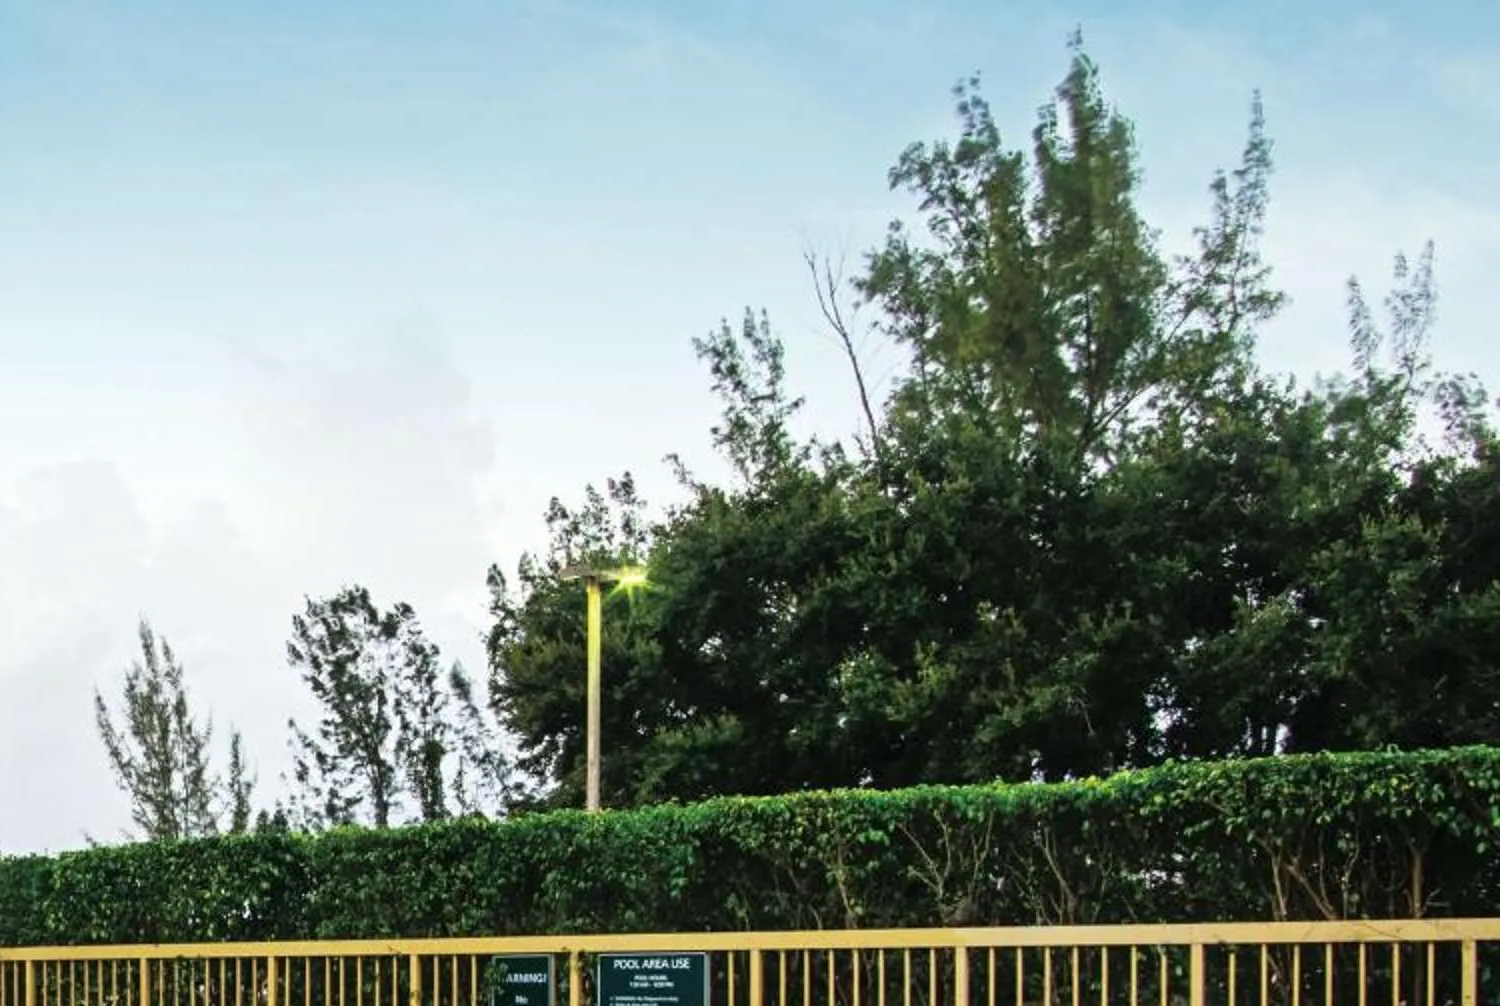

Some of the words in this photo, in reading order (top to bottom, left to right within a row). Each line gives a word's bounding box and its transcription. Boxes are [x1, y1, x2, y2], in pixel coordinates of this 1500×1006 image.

[613, 959, 640, 969] POOL
[642, 958, 670, 969] AREA
[671, 957, 691, 969] USE
[504, 973, 548, 983] ARNING!
[515, 995, 529, 1005] No
